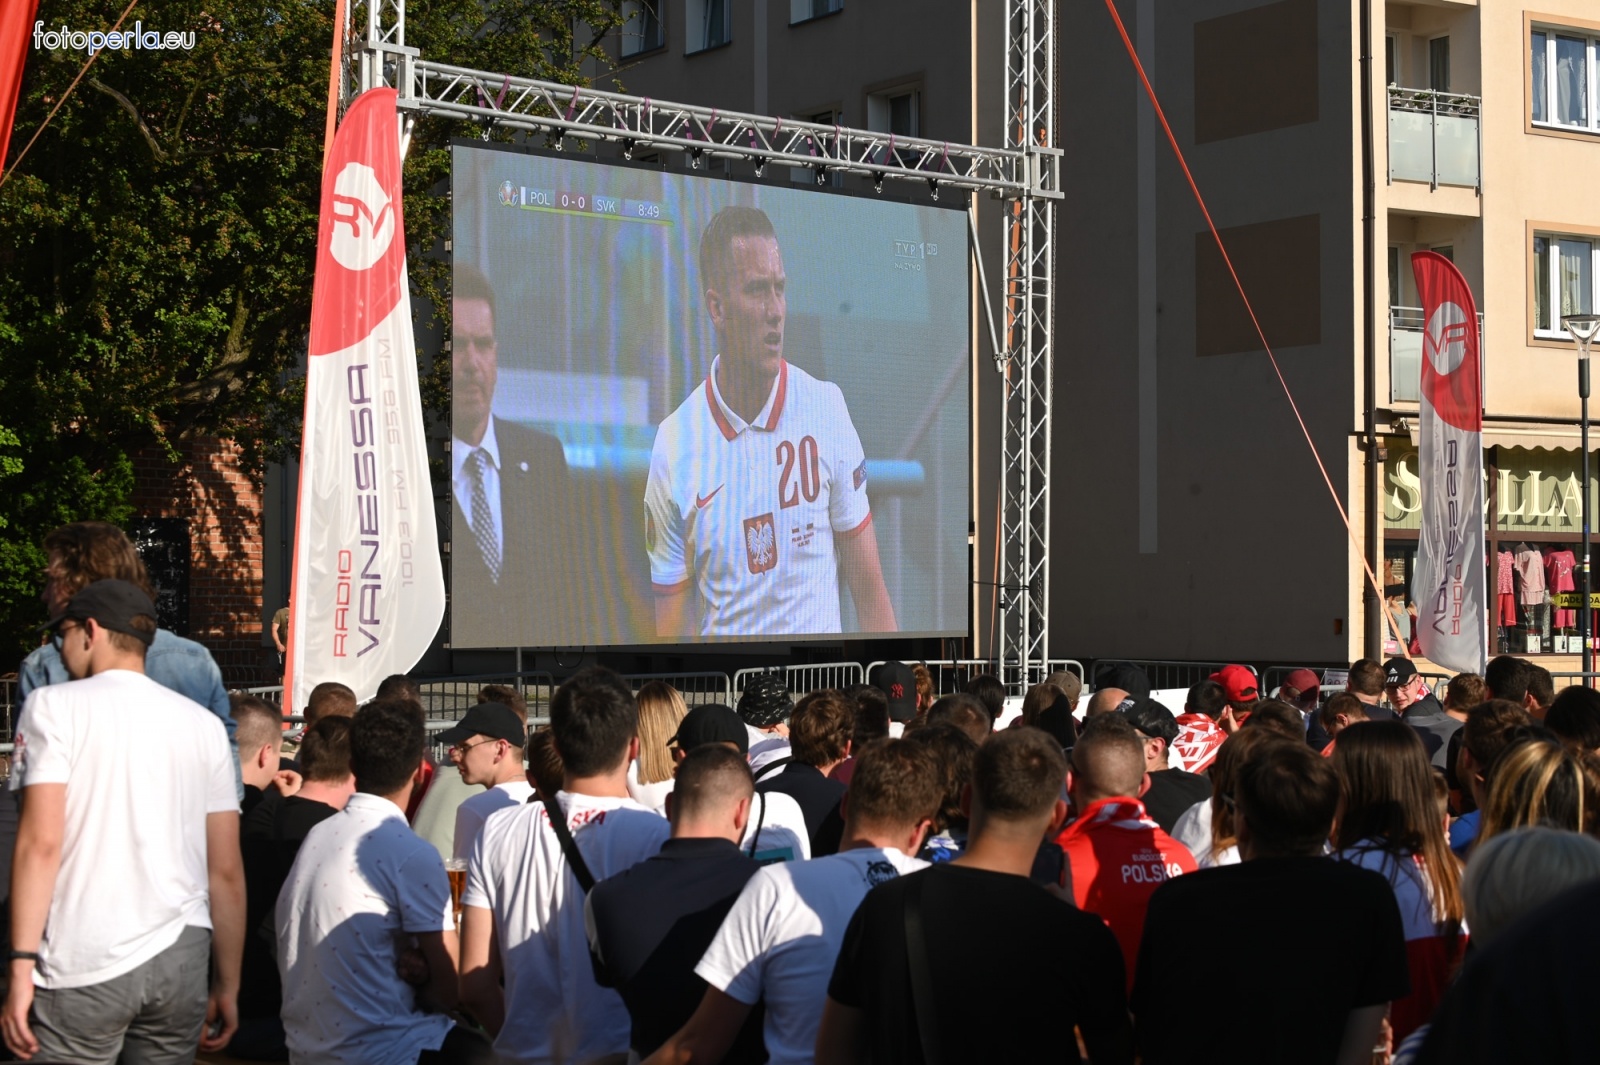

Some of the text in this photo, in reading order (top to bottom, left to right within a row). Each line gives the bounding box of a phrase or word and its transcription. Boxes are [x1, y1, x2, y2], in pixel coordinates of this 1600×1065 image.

[530, 191, 551, 206] POL
[596, 199, 616, 213] SVK
[638, 204, 660, 218] 8:49
[377, 338, 394, 379] FM
[391, 469, 408, 511] FM
[775, 434, 821, 510] 20
[1392, 452, 1583, 518] SLLA
[347, 363, 382, 658] VANESSA
[333, 549, 352, 658] RADIO
[1121, 862, 1183, 884] POLSKA
